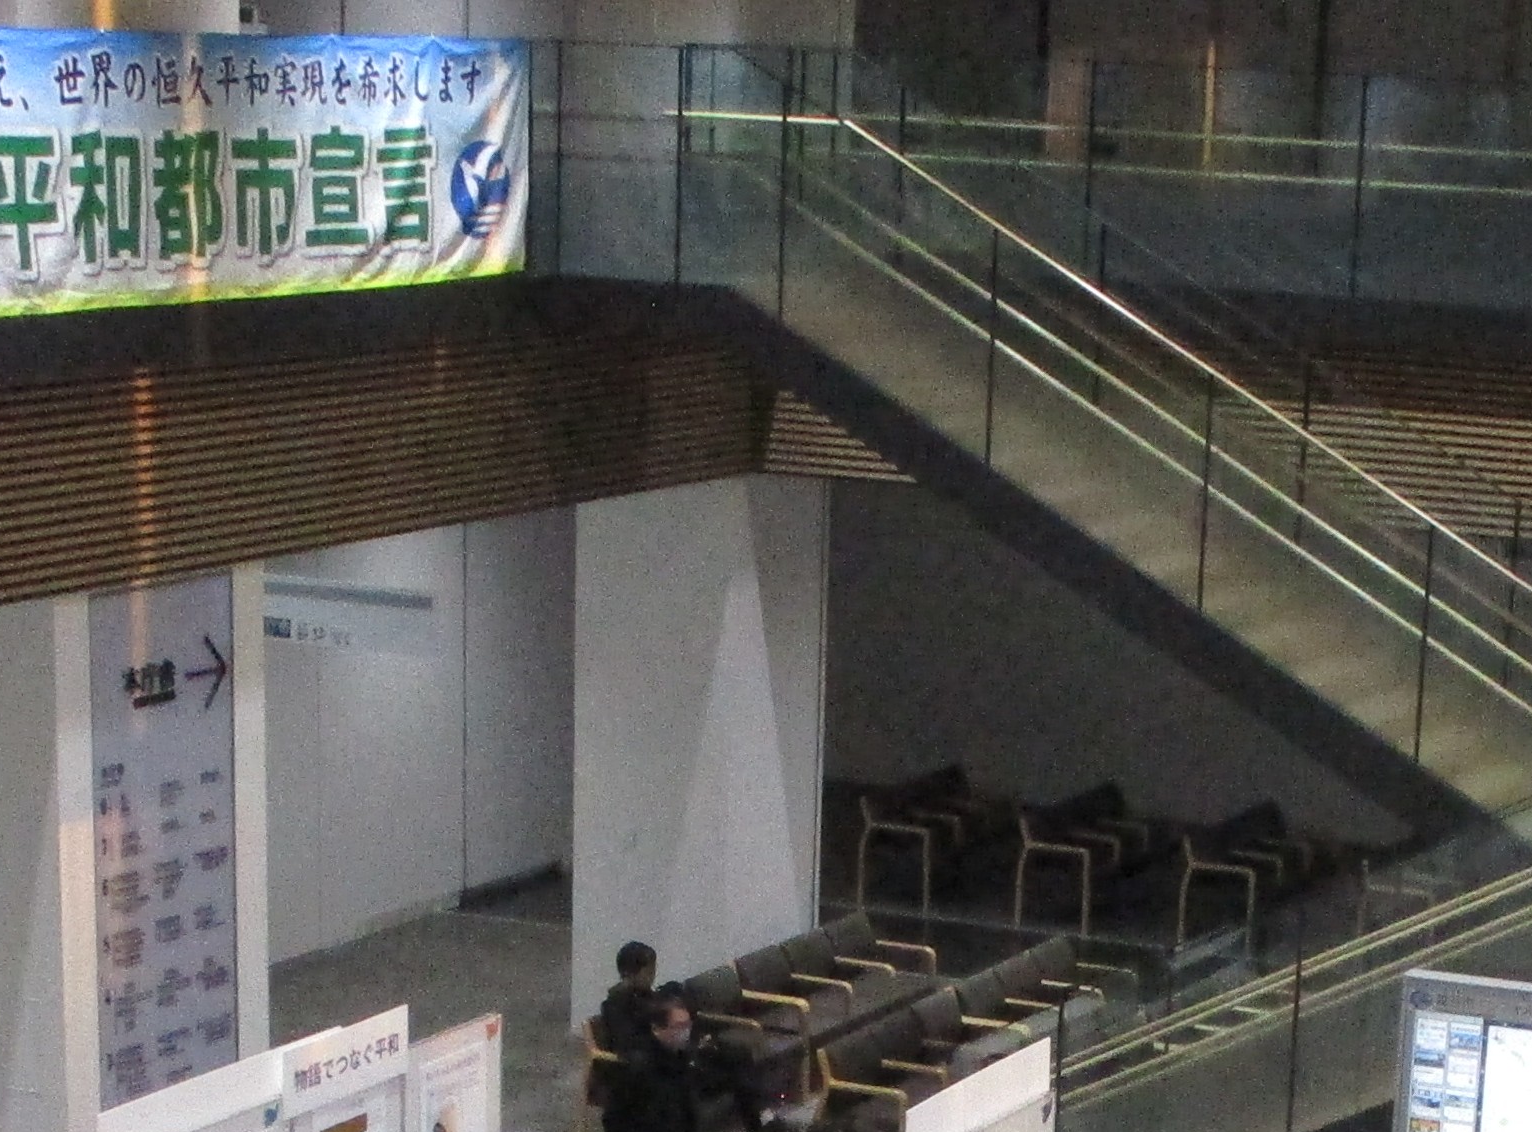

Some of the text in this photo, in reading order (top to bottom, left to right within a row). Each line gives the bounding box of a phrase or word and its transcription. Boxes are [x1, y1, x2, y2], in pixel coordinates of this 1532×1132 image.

[293, 1034, 401, 1094] 物語でつなぐ平和
